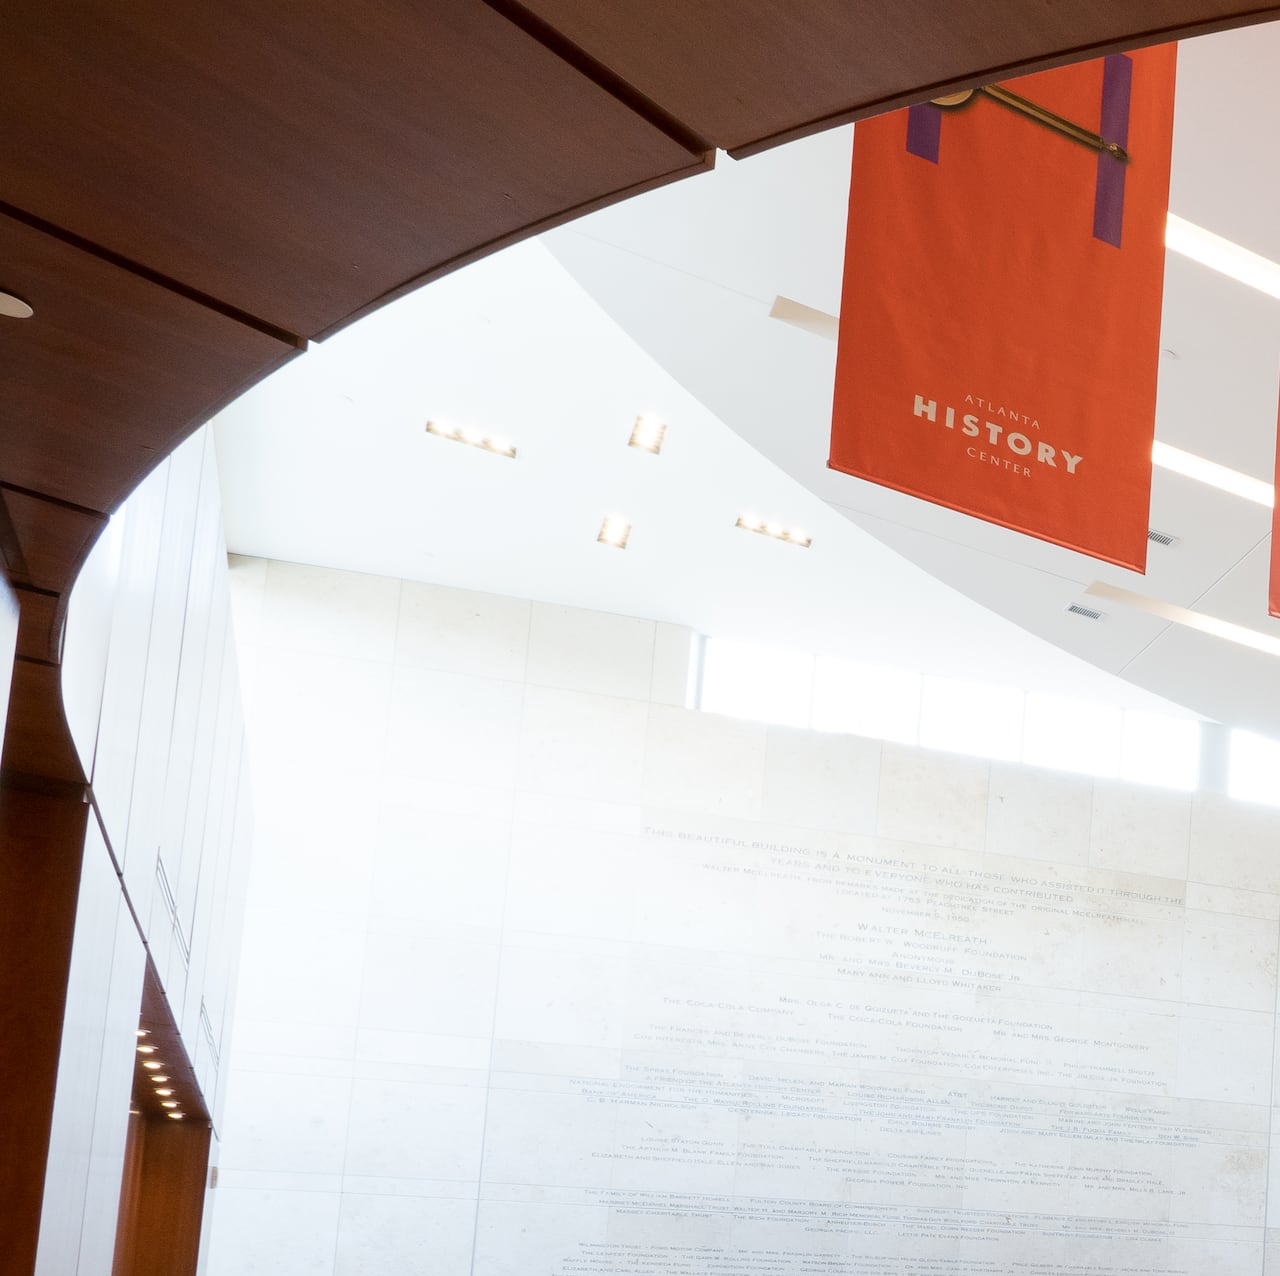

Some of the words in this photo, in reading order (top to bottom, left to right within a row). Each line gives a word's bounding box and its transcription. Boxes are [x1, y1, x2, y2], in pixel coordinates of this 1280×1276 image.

[964, 394, 1040, 430] ATLANTA
[912, 394, 1084, 474] HISTORY
[966, 447, 1032, 478] CENTER
[751, 840, 810, 856] BUILDING
[816, 850, 827, 858] IS
[832, 851, 840, 859] A
[846, 854, 916, 870] MONUMENT
[922, 863, 938, 872] TO
[942, 866, 961, 875] ALL
[968, 870, 1003, 881] THOSE
[1010, 875, 1038, 886] WHO
[1040, 881, 1094, 894] ASSISTED
[1110, 888, 1161, 902] THROUGH
[1164, 896, 1186, 906] THE
[814, 863, 840, 873] AND
[845, 866, 862, 874] TO
[864, 869, 929, 883] EVERYONE
[935, 878, 962, 889] WHO
[966, 882, 990, 892] HAS
[993, 886, 1074, 903] CONTRIBUTED
[943, 894, 994, 905] DEDICATION
[1032, 906, 1068, 915] ORIGINAL
[982, 906, 1014, 916] STREET
[857, 922, 908, 936] WALTER
[839, 934, 881, 944] ROBERT
[903, 940, 957, 953] WOODRUFF
[964, 947, 1028, 961] FOUNDATION
[891, 952, 955, 964] ANONYMOUS
[895, 961, 942, 973] BEVERLY
[836, 967, 865, 978] MARY
[892, 974, 913, 983] AND
[916, 976, 948, 986] LLOYD
[952, 980, 1001, 992] WHITAKER
[827, 1012, 844, 1020] THE
[905, 1020, 963, 1032] FOUNDATION
[912, 1010, 930, 1018] AND
[932, 1012, 949, 1020] THE
[952, 1014, 996, 1025] GOIZUETA
[998, 1018, 1053, 1030] FOUNDATION
[1053, 1034, 1089, 1045] GEORGE
[1093, 1038, 1150, 1051] MONTGOMERY
